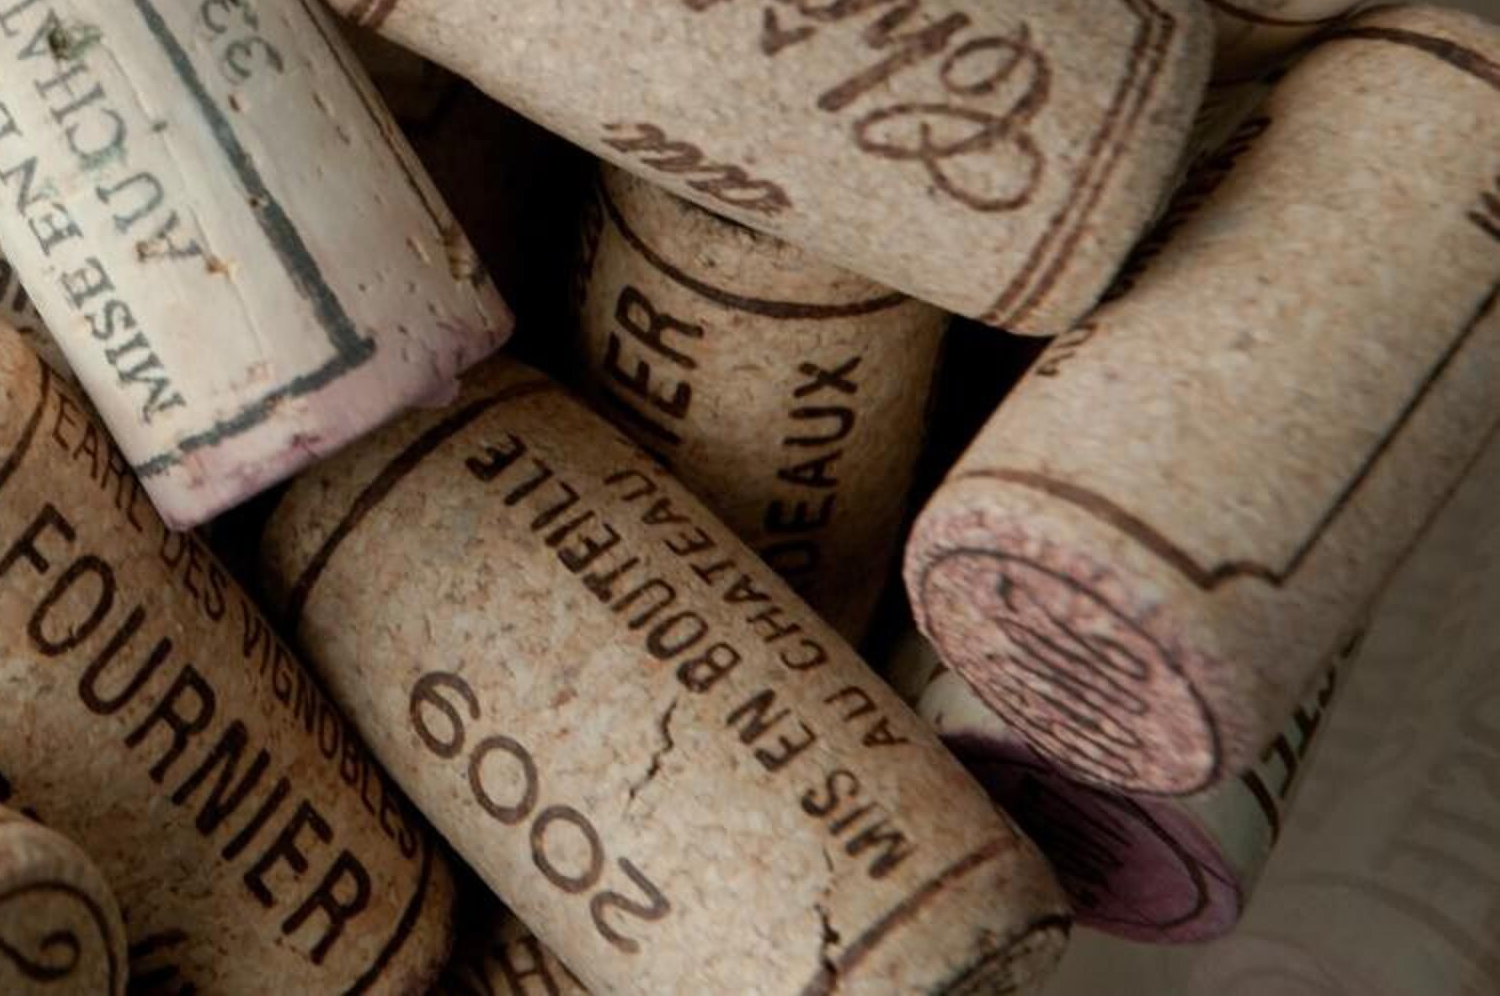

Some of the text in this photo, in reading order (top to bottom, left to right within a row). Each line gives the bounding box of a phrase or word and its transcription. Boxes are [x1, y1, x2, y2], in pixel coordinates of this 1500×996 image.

[61, 255, 187, 426] MISE
[94, 170, 204, 266] AU
[465, 431, 915, 880] MIS EN BOUTEILLE
[604, 465, 907, 750] AU CHATEAU
[409, 669, 672, 954] 2009
